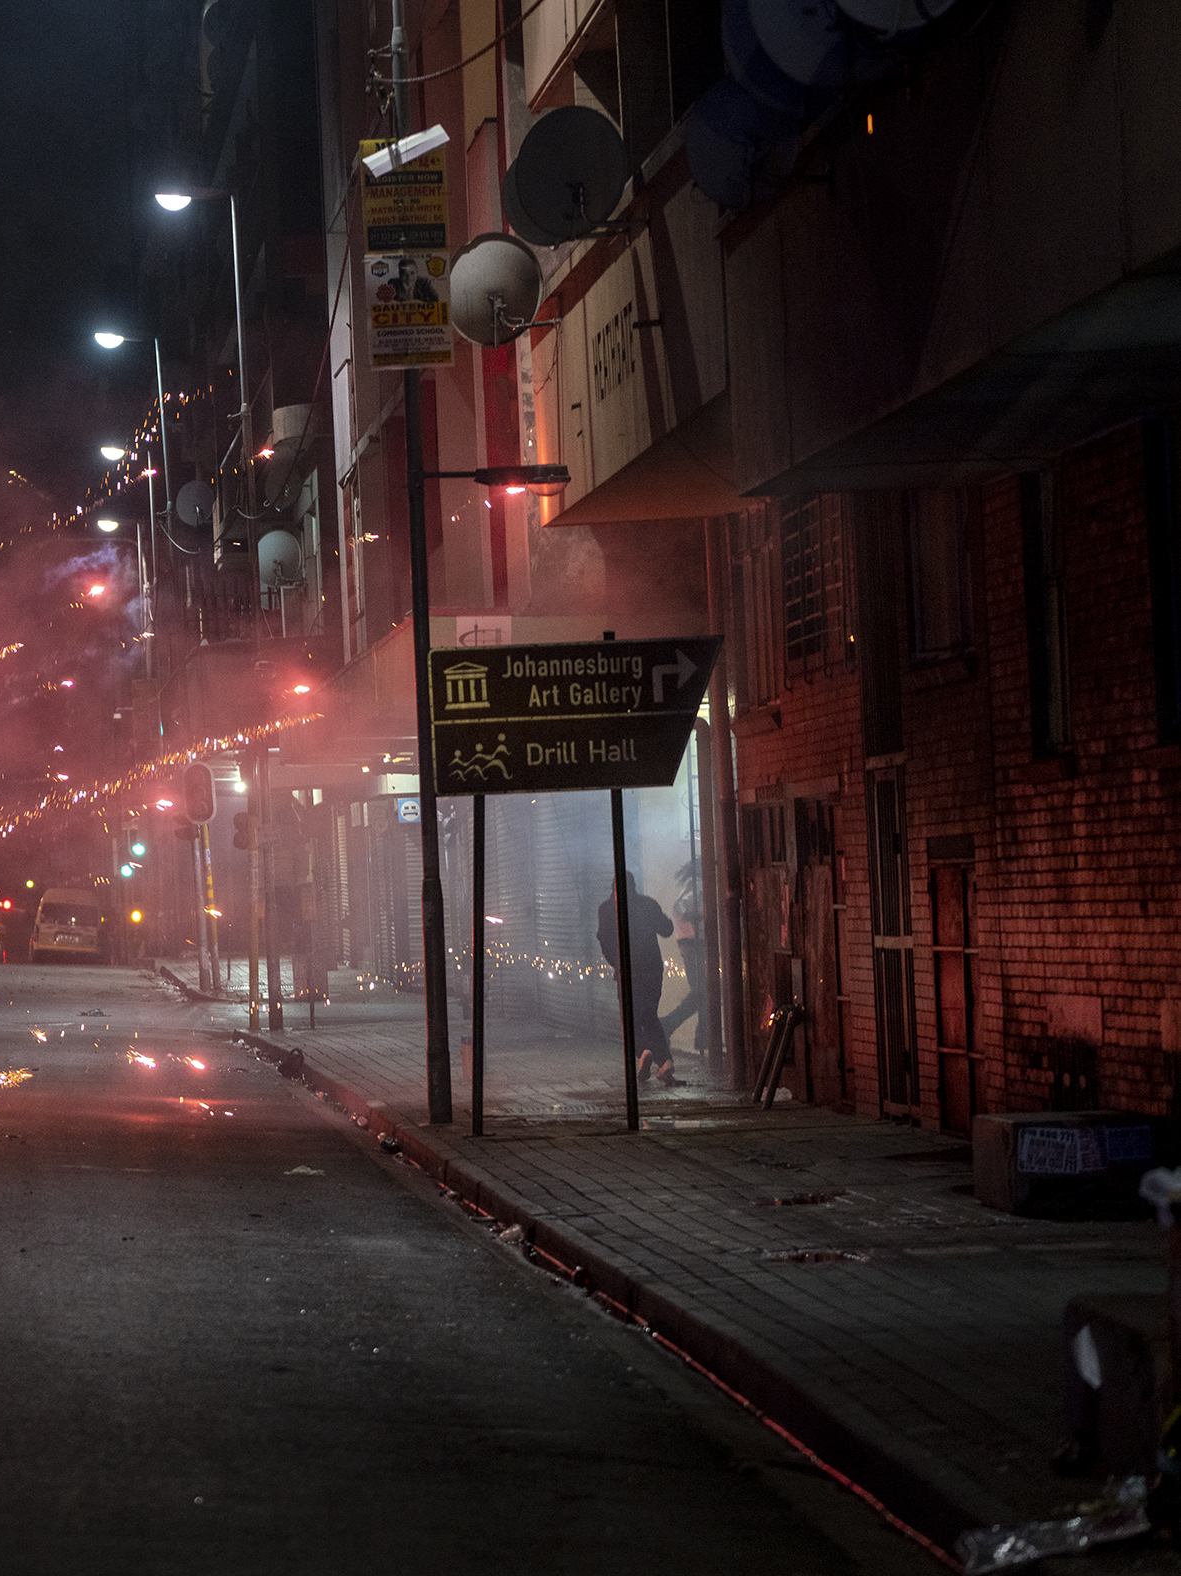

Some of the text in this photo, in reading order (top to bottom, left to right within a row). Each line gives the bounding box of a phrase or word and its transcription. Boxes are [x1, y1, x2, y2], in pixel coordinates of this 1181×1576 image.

[417, 173, 438, 182] NOW
[371, 186, 442, 199] MANAGEMENT
[372, 215, 396, 225] ADULT
[373, 303, 435, 313] GAUTENG
[373, 311, 435, 325] CITY
[377, 327, 445, 338] COMBINED SCHOOL
[502, 652, 643, 680] Johannesburg
[528, 681, 643, 710] Art Gallery
[526, 738, 638, 767] Drill Hall
